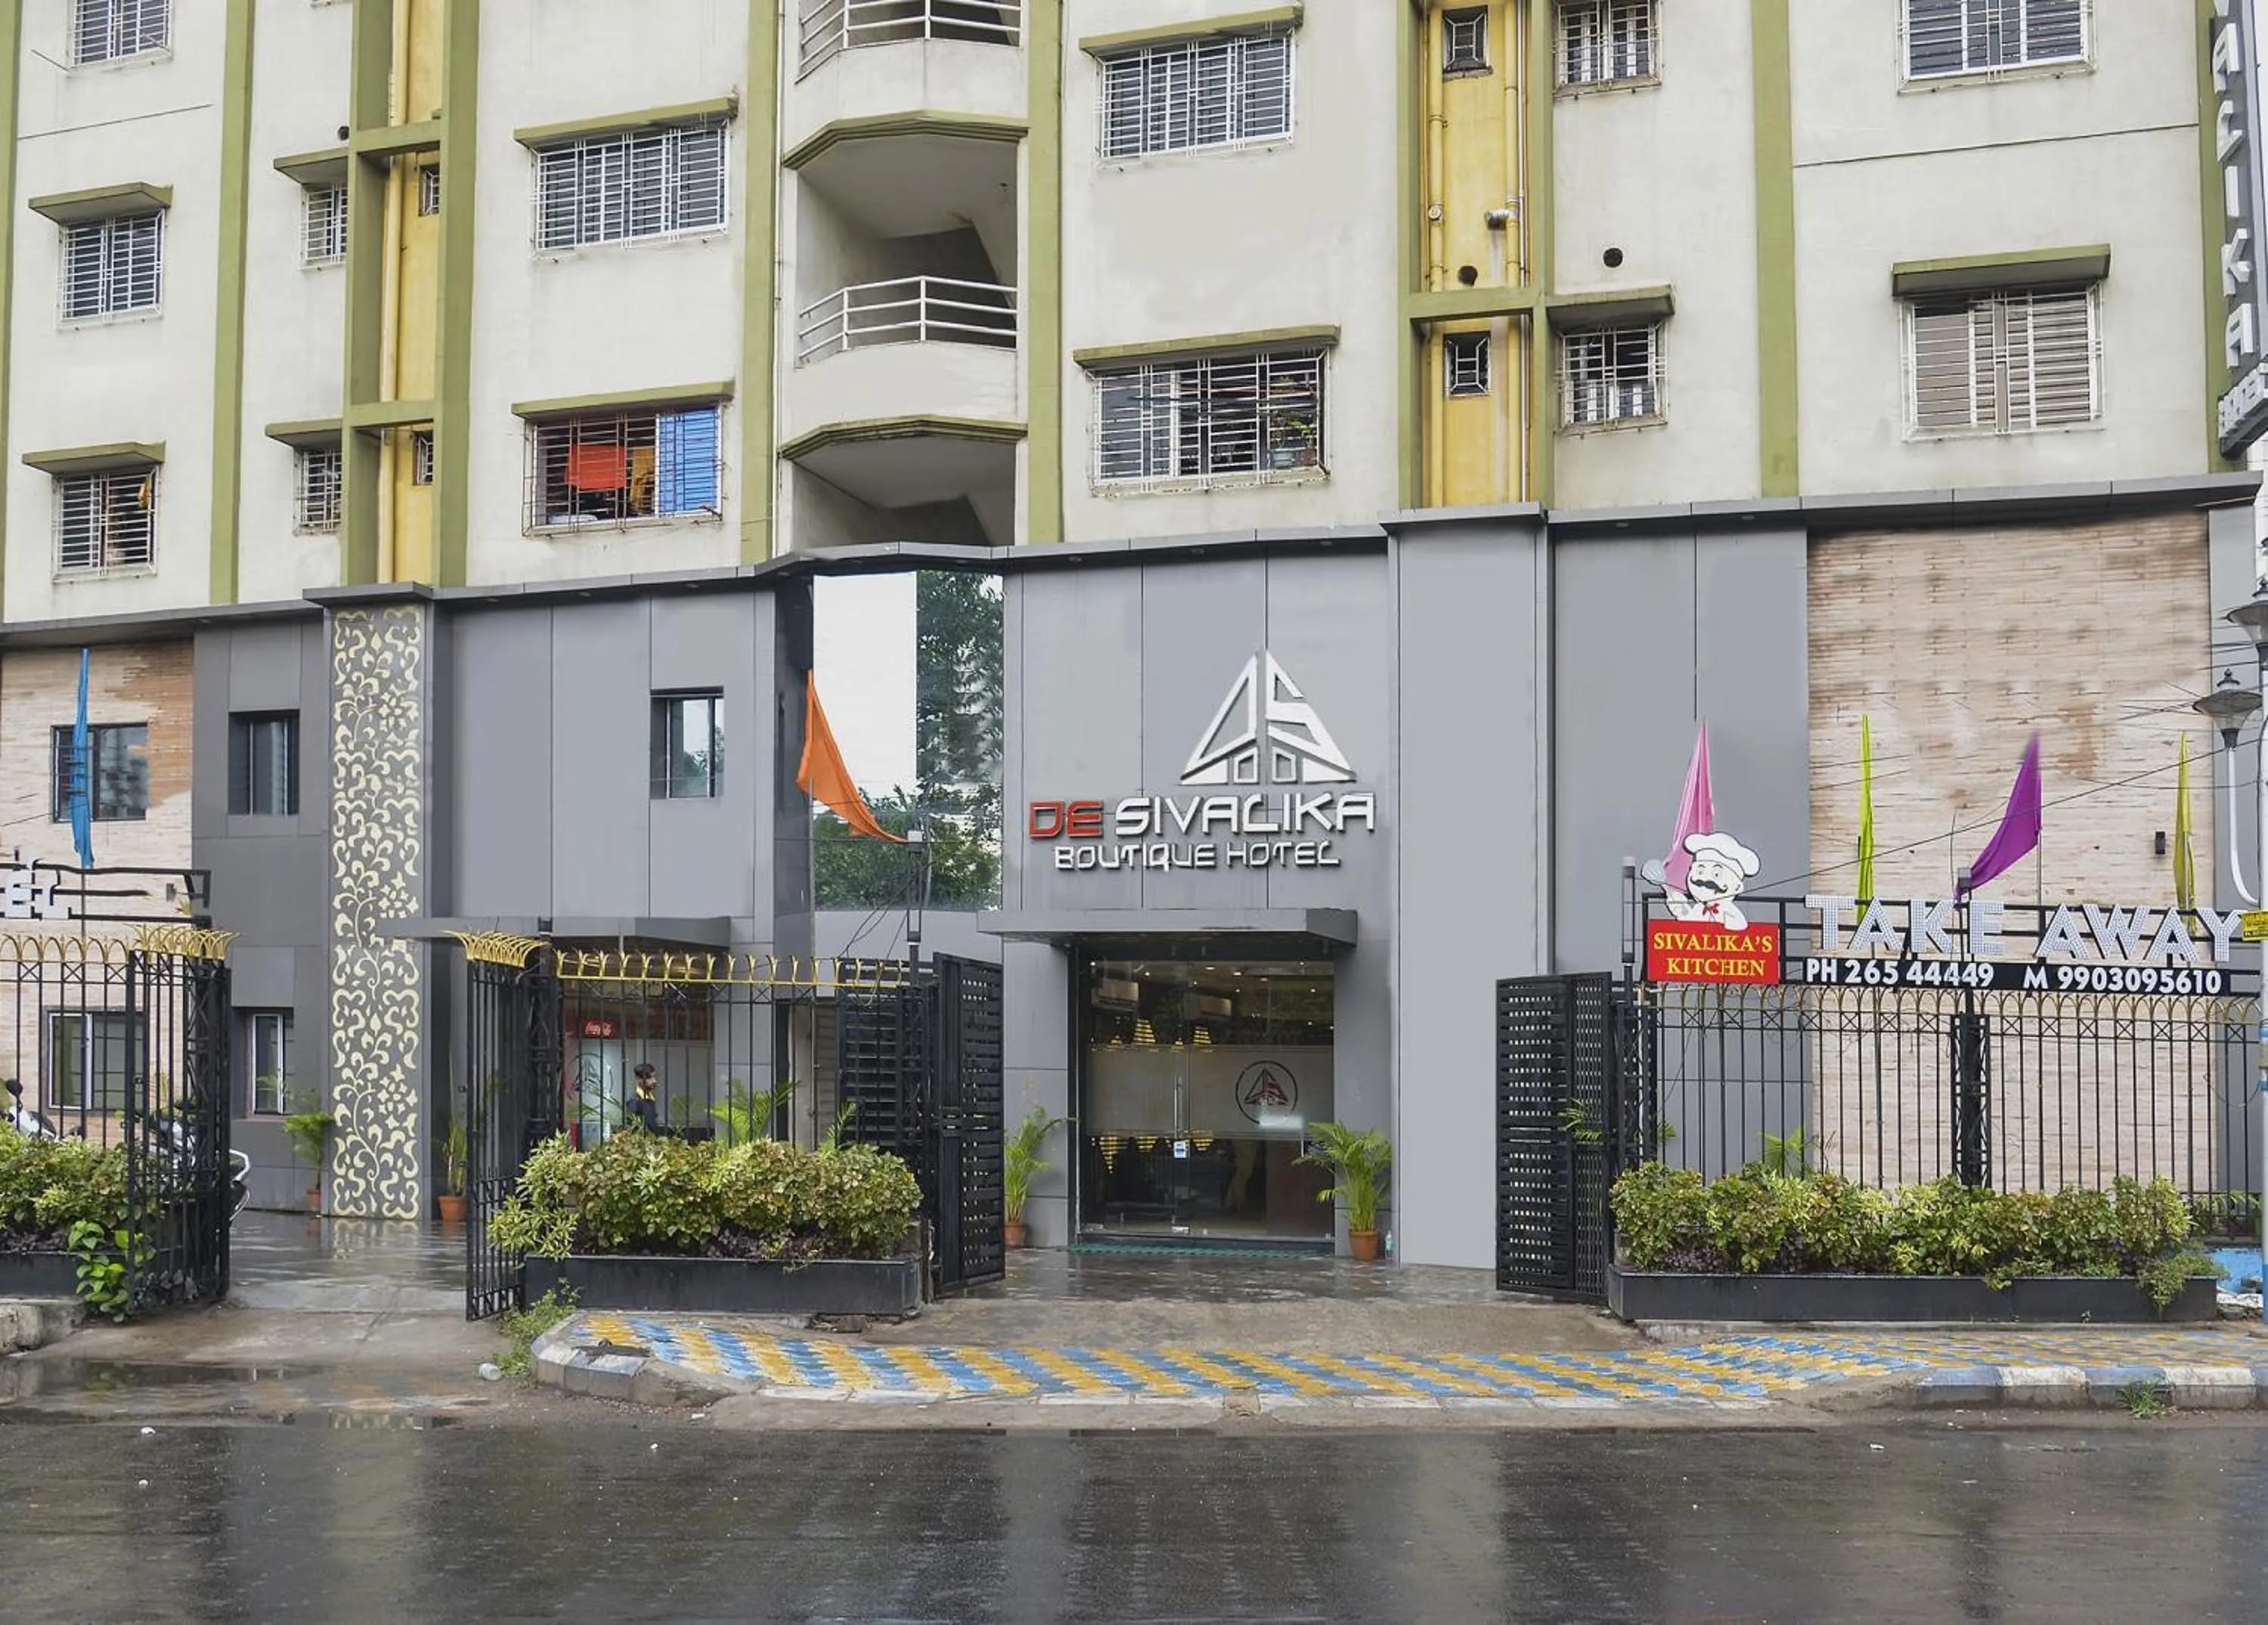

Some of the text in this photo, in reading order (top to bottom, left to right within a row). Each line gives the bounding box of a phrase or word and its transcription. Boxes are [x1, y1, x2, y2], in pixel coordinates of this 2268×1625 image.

[2212, 0, 2254, 369] ALIKA
[1029, 792, 1374, 838] DE SIVALIKA
[1055, 840, 1341, 871] BOUTIQUE HOTEL
[1653, 932, 1773, 953] SIVALIKA'S
[1805, 895, 2004, 954] TAKE
[2034, 903, 2245, 962] AWAY
[1666, 958, 1766, 977] KITCHEN
[1807, 958, 2222, 995] PH 265 44449 M 9903095610
